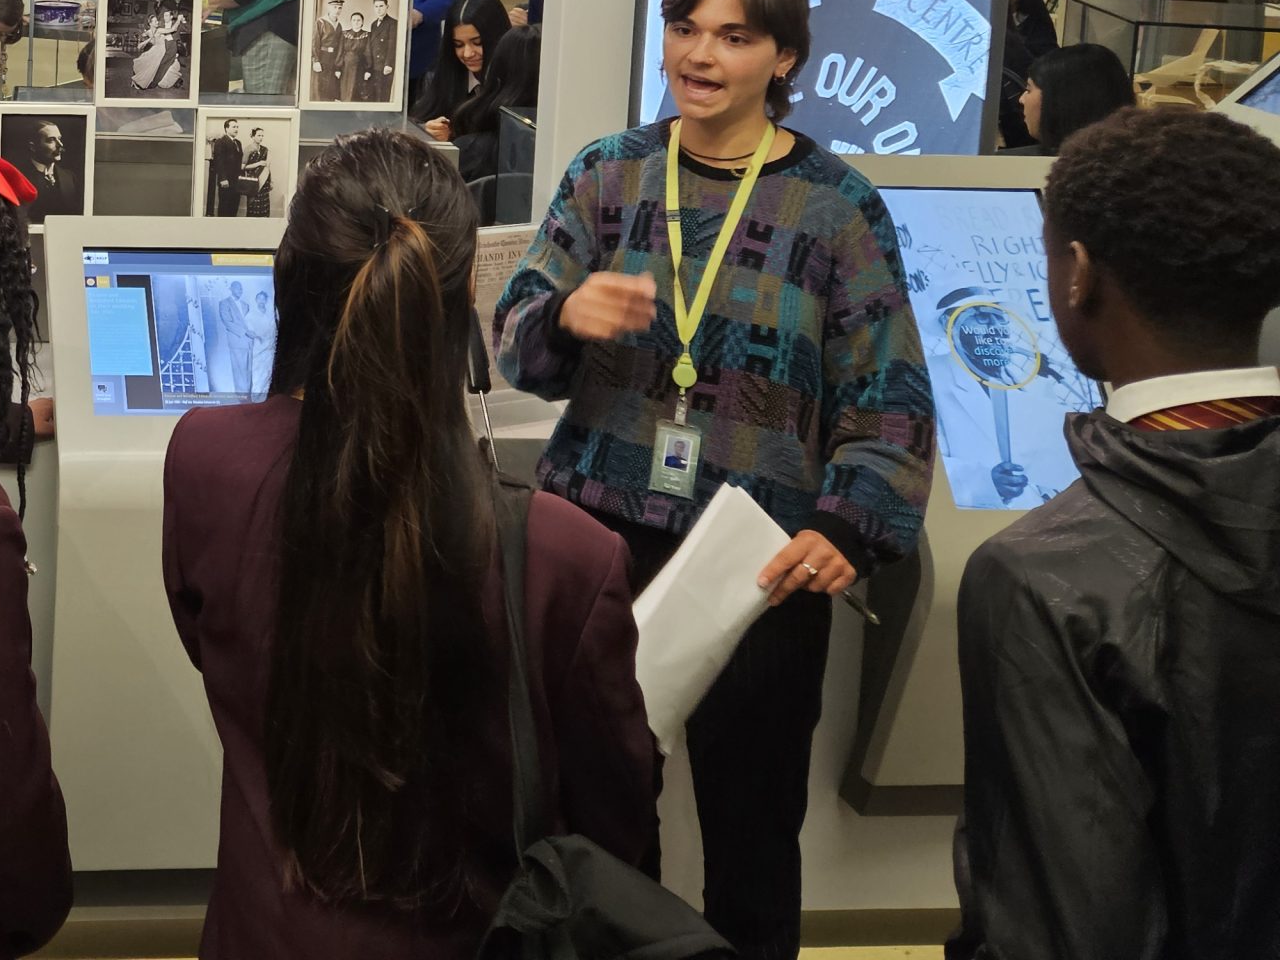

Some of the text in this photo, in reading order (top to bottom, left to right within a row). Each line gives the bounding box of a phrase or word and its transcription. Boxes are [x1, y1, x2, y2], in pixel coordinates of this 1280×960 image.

[815, 52, 897, 127] OUR
[962, 325, 996, 335] Would
[974, 335, 993, 346] like
